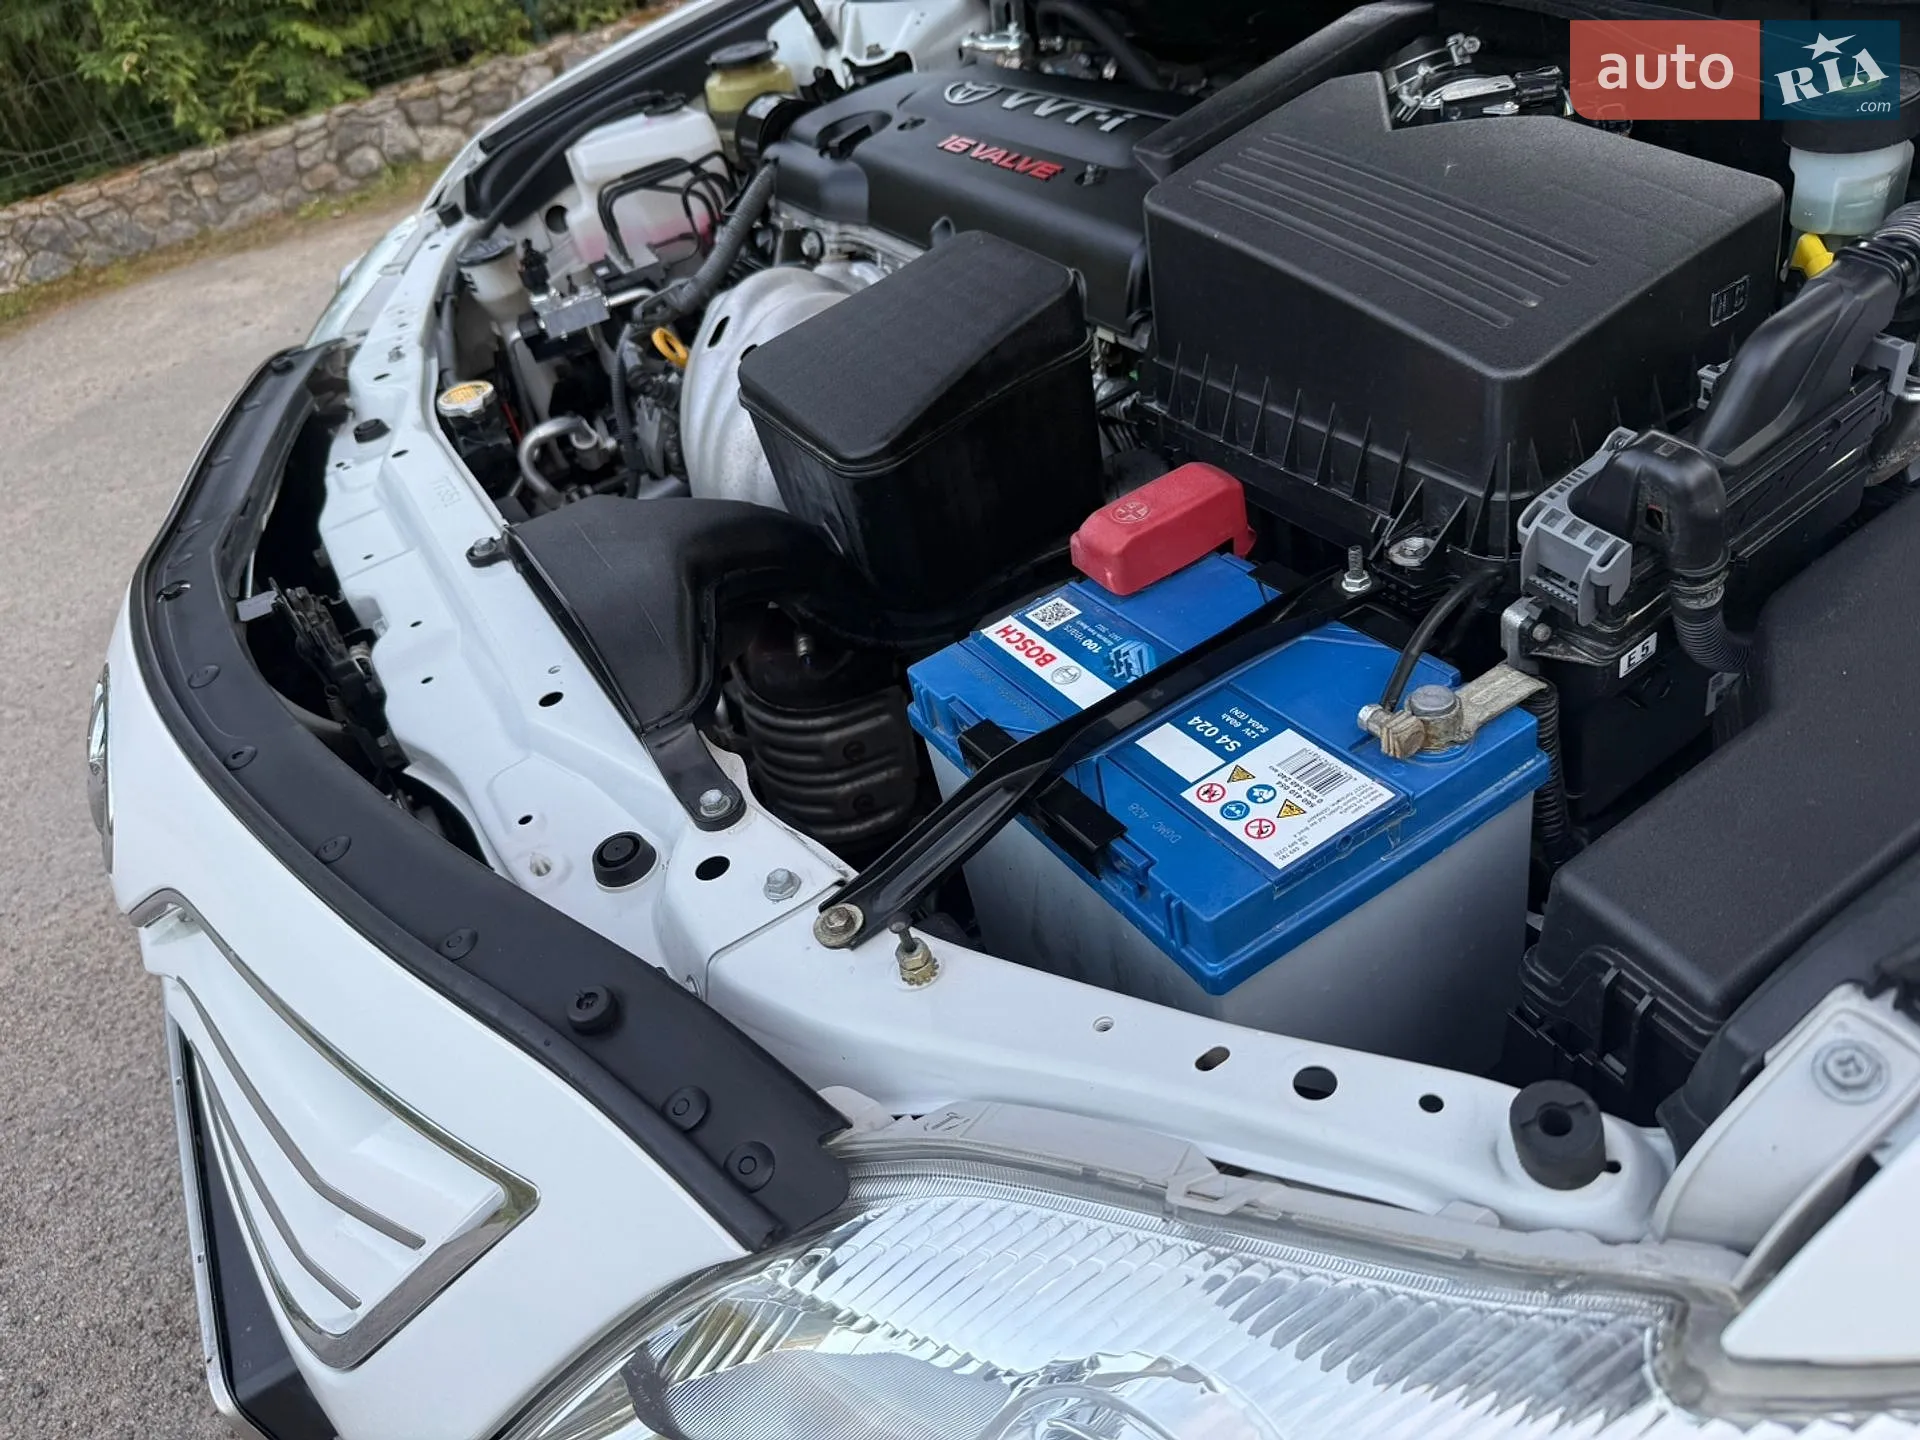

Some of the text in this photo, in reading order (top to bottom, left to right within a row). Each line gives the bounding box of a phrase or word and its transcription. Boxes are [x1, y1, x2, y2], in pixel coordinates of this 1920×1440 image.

[937, 134, 1064, 180] 16 VALVE
[995, 624, 1057, 667] BOSCH
[1081, 638, 1103, 654] 100
[1627, 641, 1649, 668] E 5
[1187, 716, 1242, 752] S4 024
[1221, 713, 1260, 739] 12V 60Ah
[1229, 706, 1270, 734] 540A (EN)
